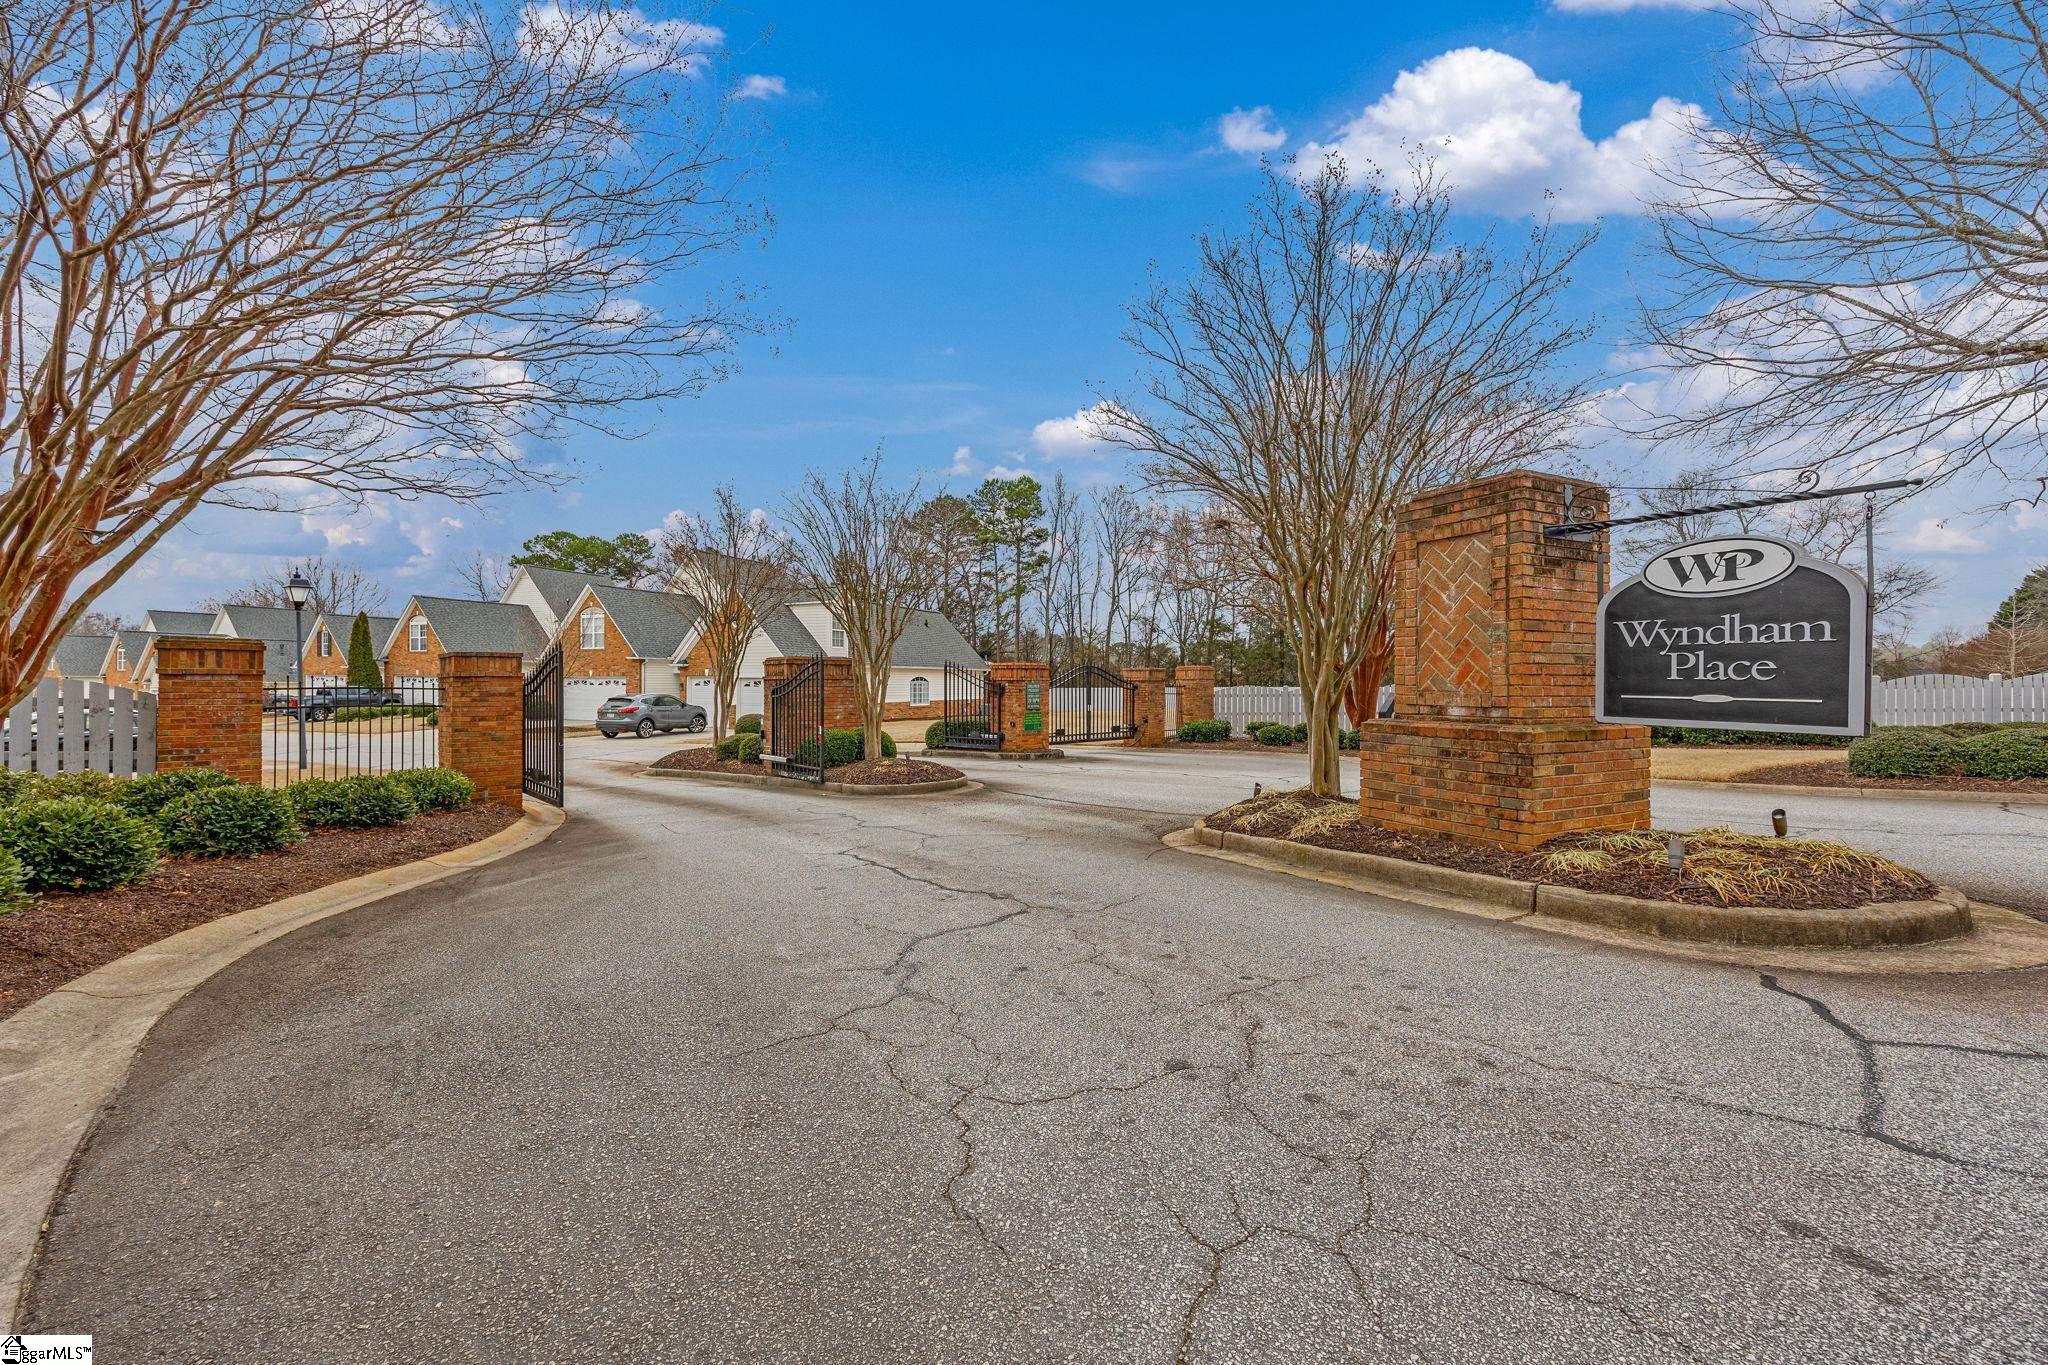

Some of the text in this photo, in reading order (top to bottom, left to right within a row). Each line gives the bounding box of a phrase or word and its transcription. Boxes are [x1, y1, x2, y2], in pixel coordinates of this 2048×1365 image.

[1663, 548, 1764, 588] WP
[1612, 613, 1837, 655] Wyndham
[1666, 650, 1778, 681] Place
